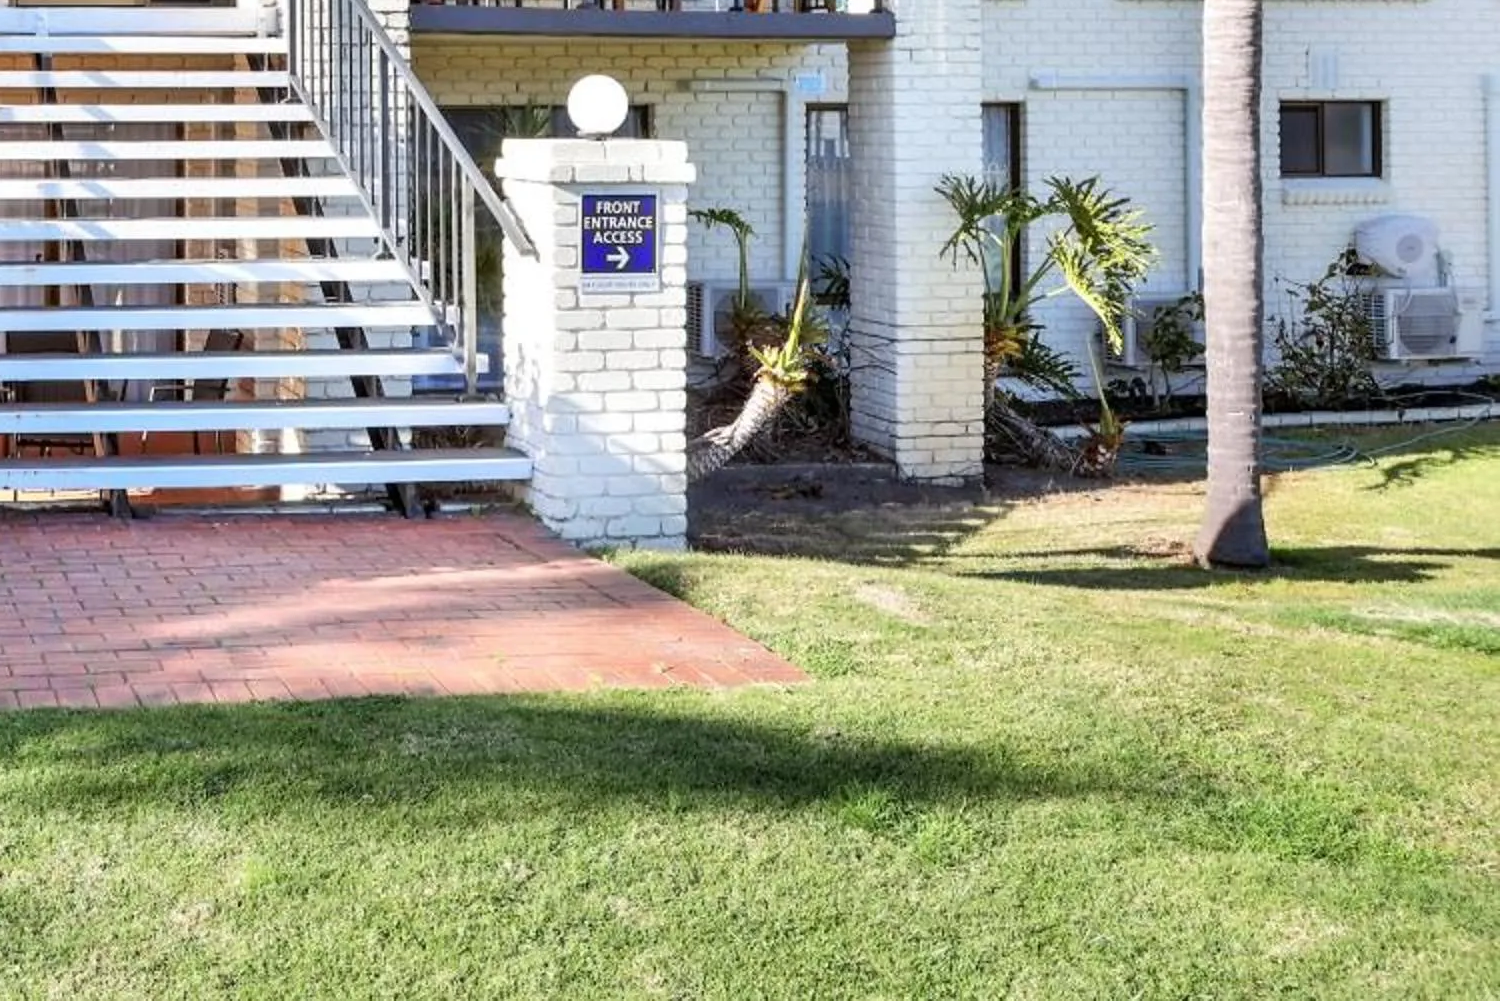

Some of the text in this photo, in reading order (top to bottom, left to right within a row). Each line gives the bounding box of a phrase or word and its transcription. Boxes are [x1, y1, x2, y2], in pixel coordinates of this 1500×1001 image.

[596, 200, 641, 214] FRONT
[583, 216, 653, 230] ENTRANCE
[593, 230, 644, 244] ACCESS
